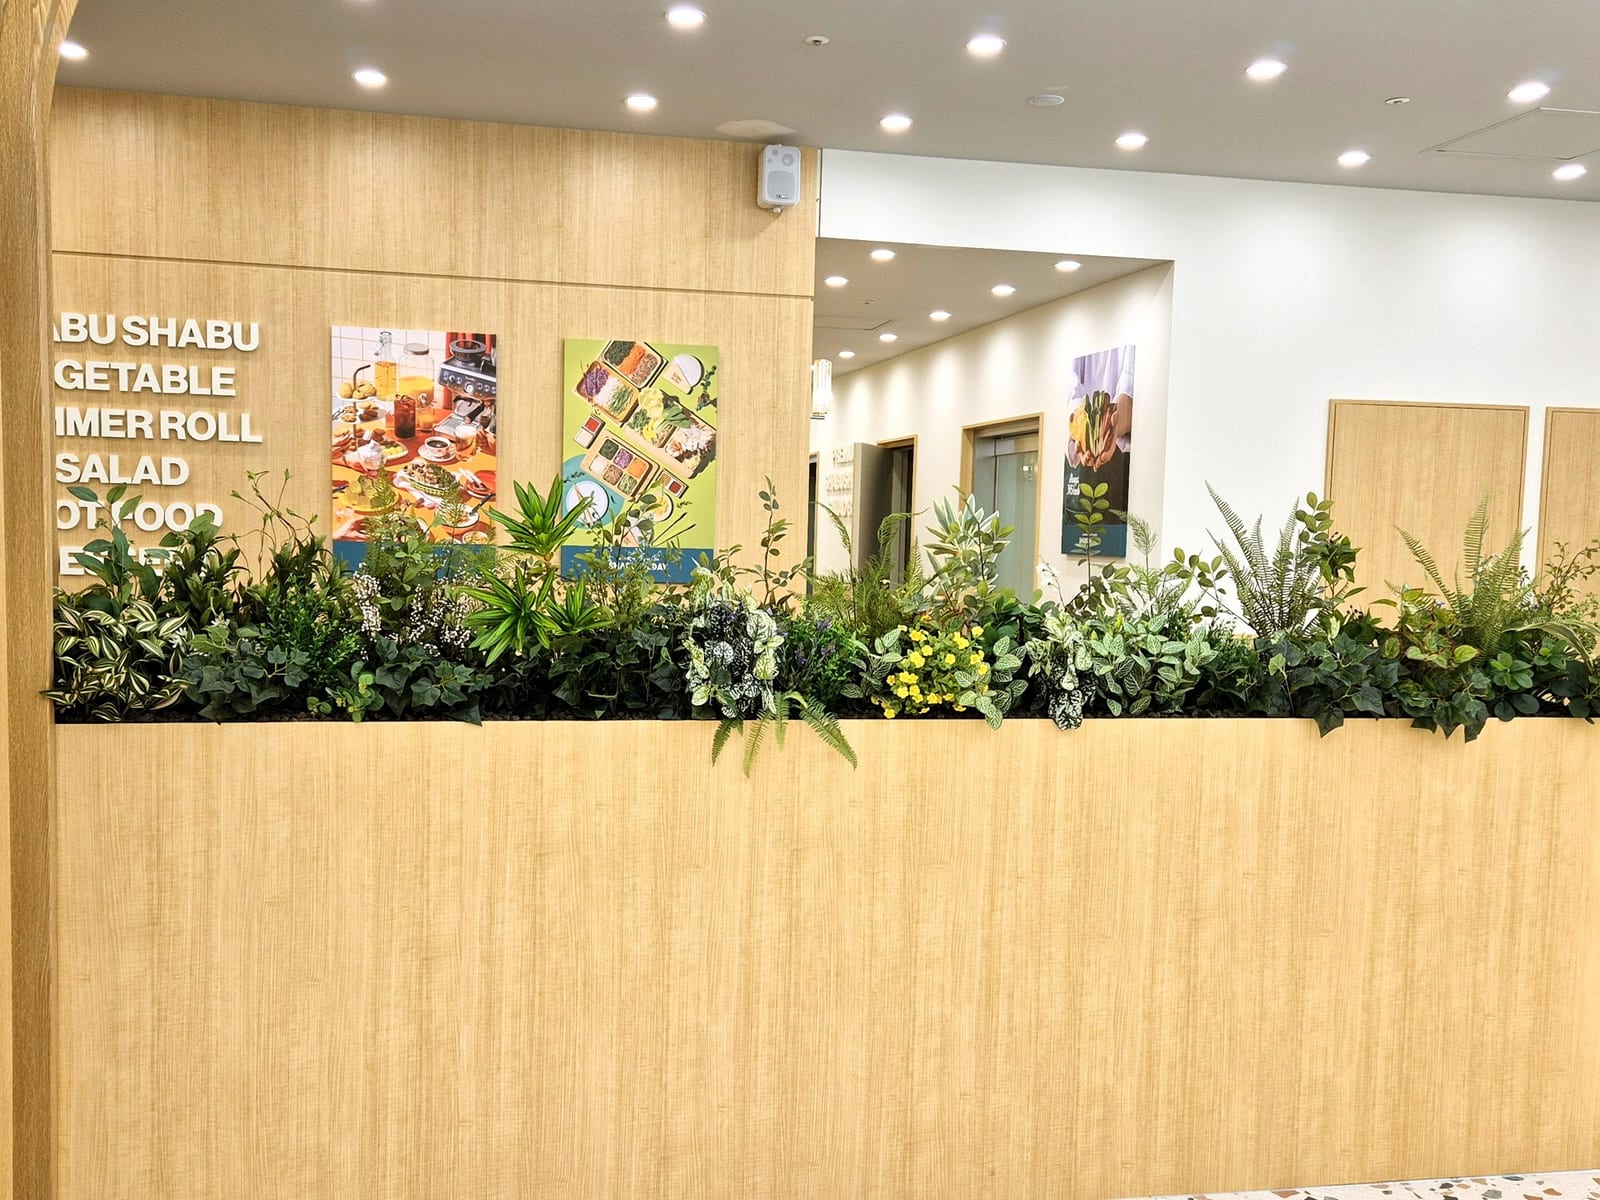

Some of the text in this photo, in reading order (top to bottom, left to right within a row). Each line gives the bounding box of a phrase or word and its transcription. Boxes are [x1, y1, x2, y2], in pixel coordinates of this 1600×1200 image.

[122, 315, 259, 352] SHABU
[54, 359, 236, 397] GETABLE
[160, 410, 263, 443] ROLL
[56, 453, 190, 486] SALAD
[57, 499, 104, 530] OT
